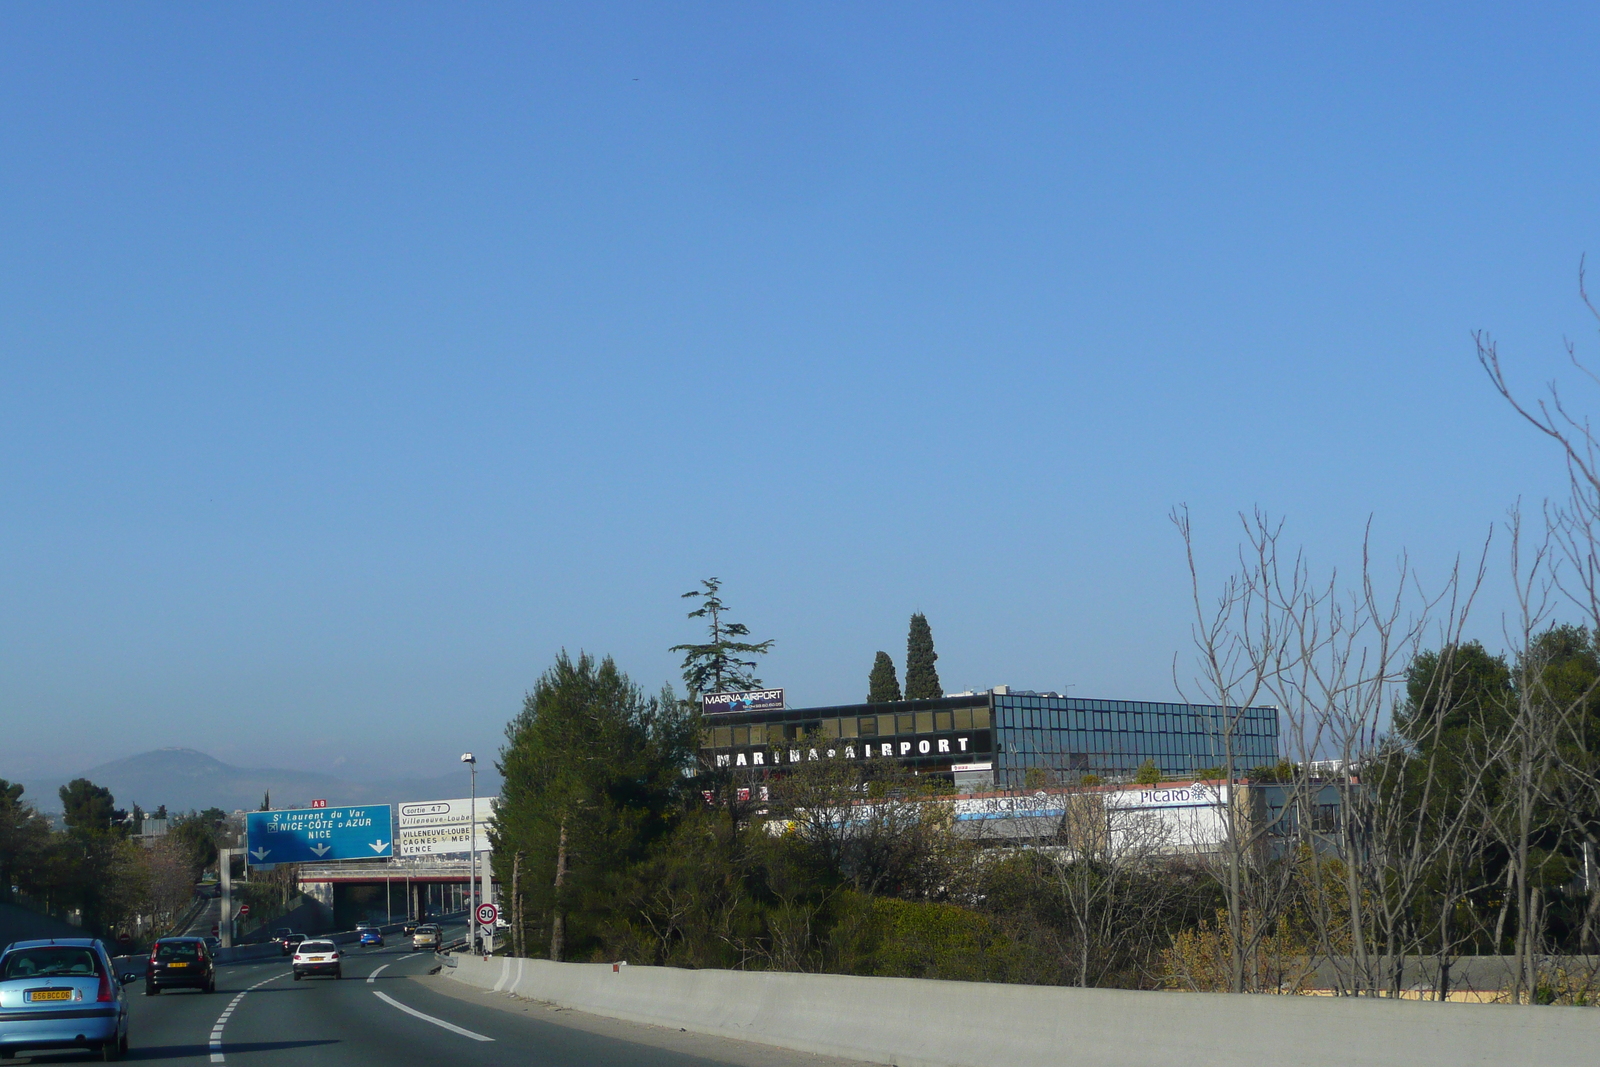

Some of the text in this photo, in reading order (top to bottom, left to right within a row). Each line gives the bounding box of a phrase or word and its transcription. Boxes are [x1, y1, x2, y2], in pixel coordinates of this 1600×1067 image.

[705, 690, 782, 704] MARINA AIRPORT
[716, 738, 968, 767] MARINA AIRPORT
[287, 812, 324, 821] Laurent
[331, 811, 342, 819] du
[406, 807, 426, 815] sortie
[280, 819, 333, 831] NICE-CÔTE
[345, 818, 372, 828] AZUR
[308, 830, 331, 839] NICE
[402, 827, 472, 838] VILLENEUVE-LOUBE
[402, 837, 437, 846] CAGNES
[403, 845, 432, 853] VENCE
[480, 909, 493, 919] 90
[32, 990, 70, 1000] 656 BCC 06
